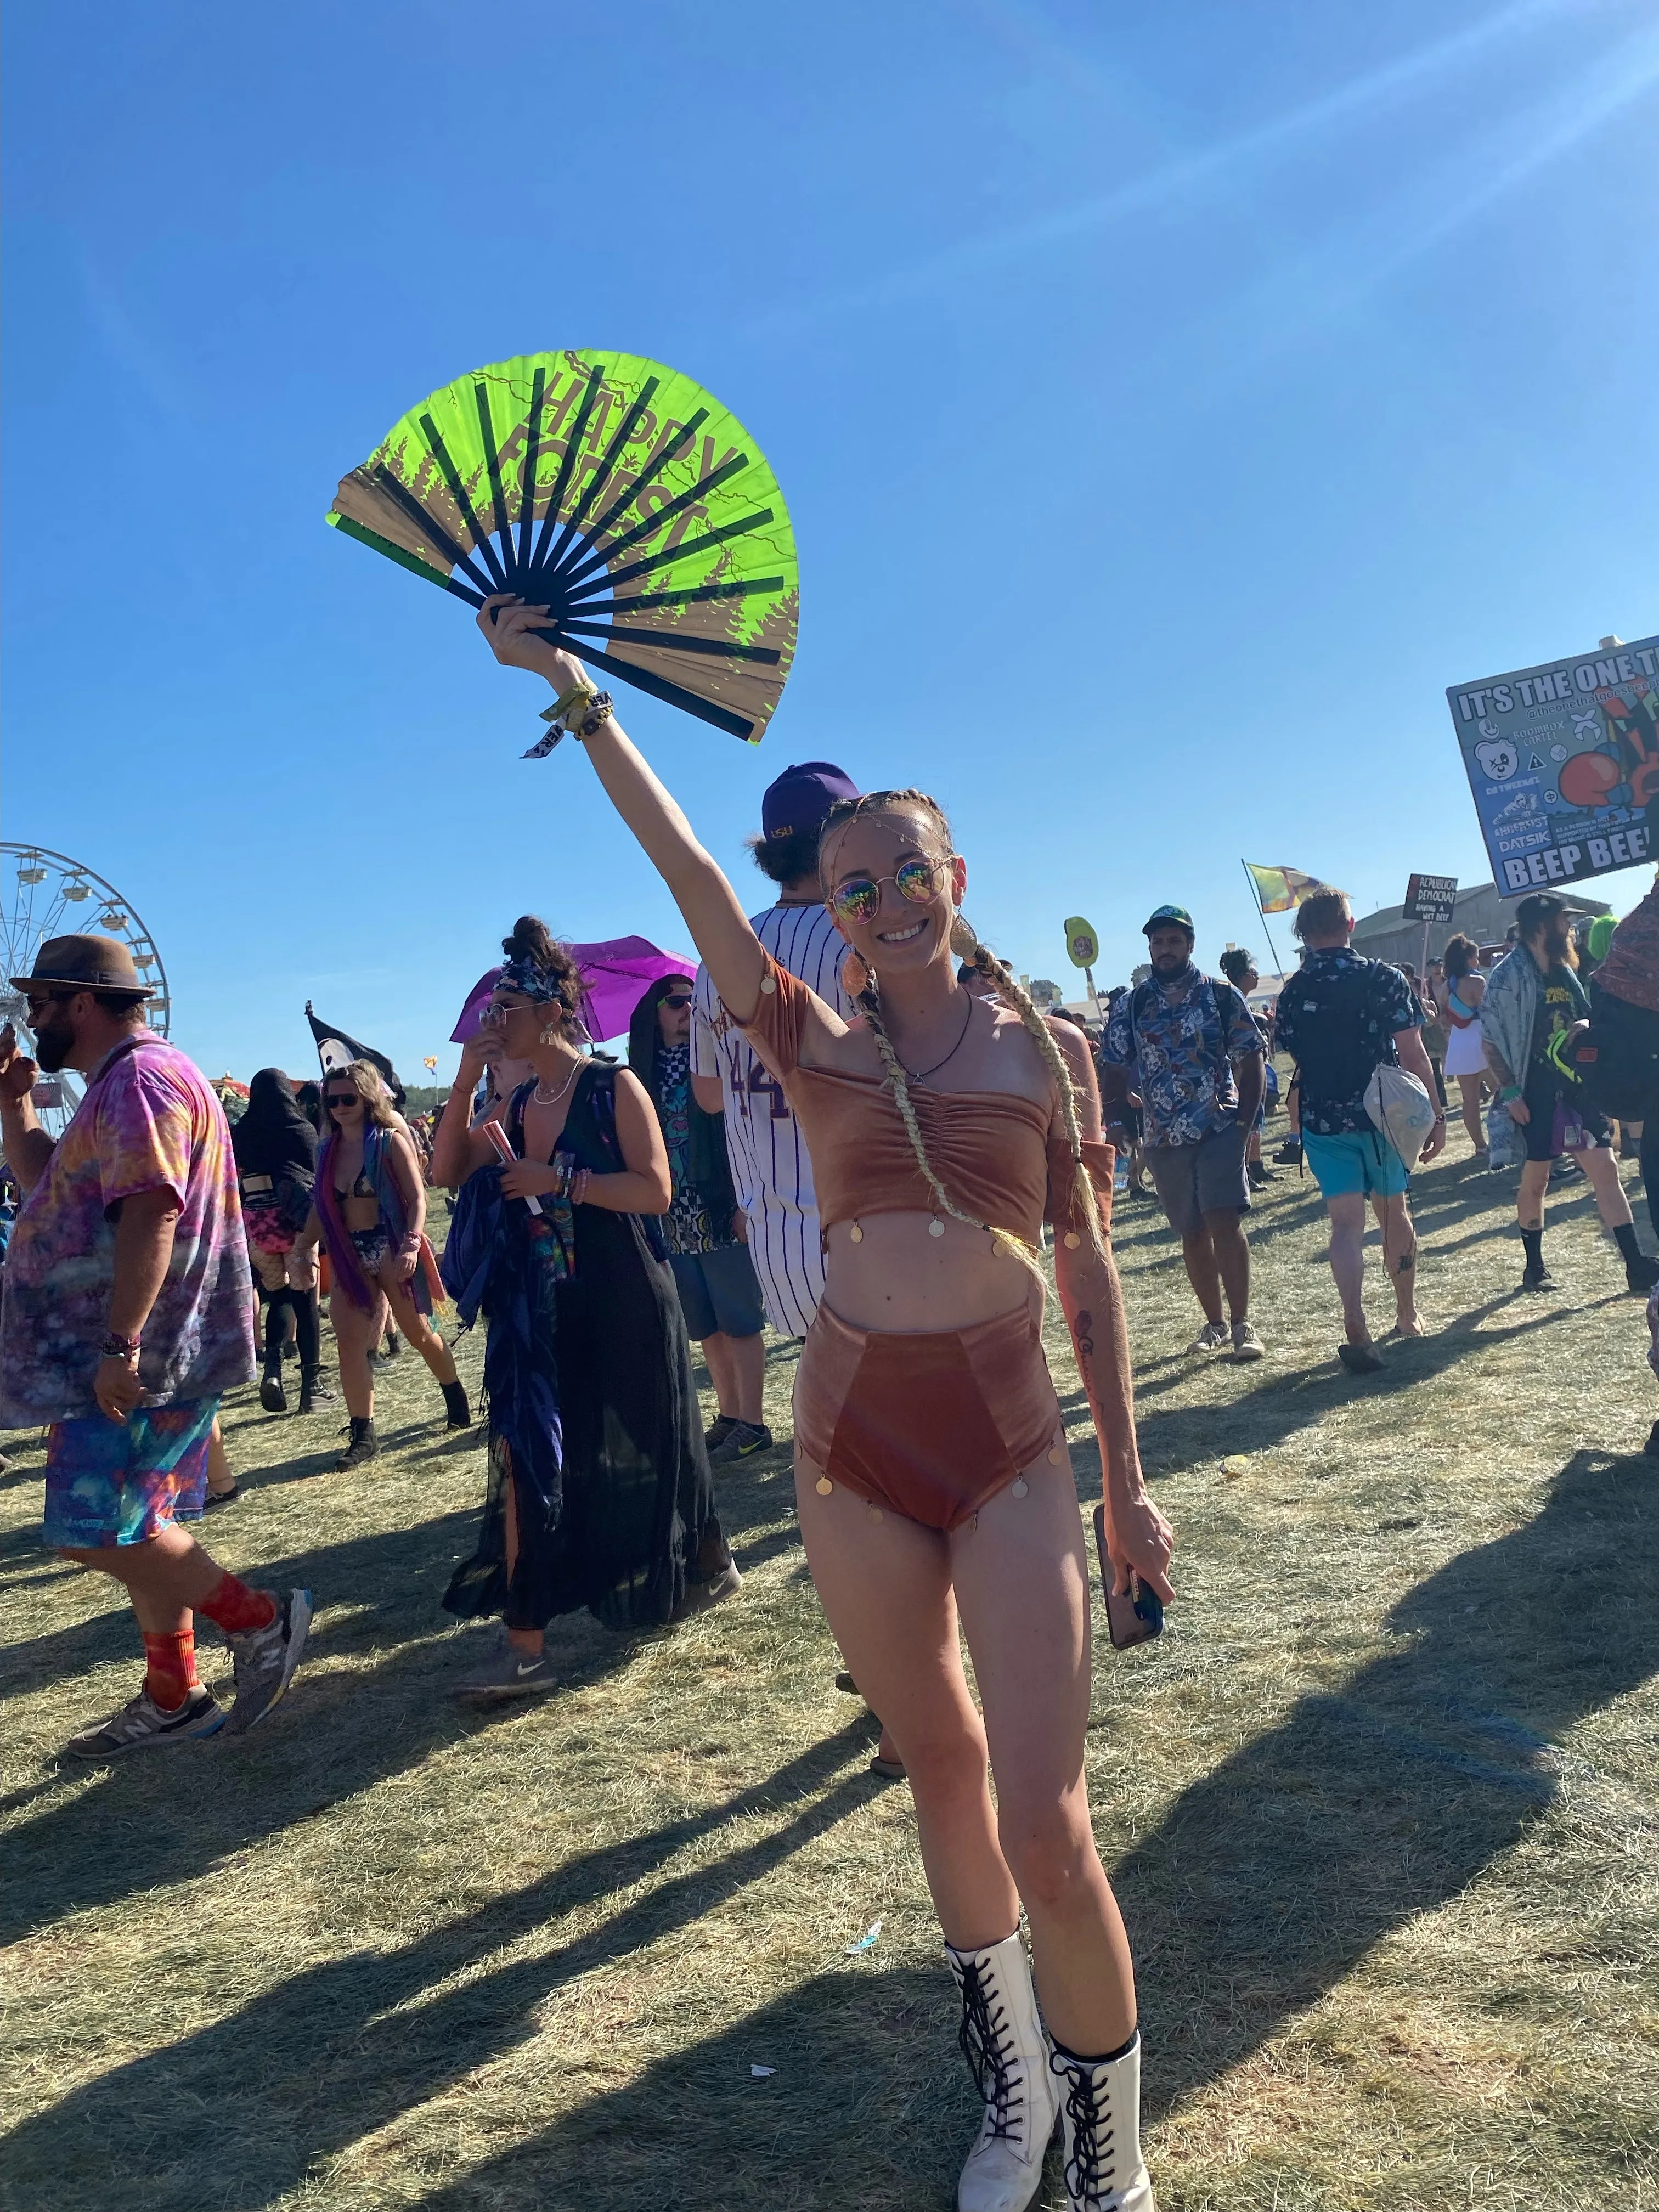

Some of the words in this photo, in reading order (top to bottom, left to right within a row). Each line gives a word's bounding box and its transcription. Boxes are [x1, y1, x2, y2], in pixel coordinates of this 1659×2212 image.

[523, 371, 739, 503] HAPPY
[488, 422, 709, 558] FOREST
[1458, 686, 1514, 720] IT'S
[1516, 671, 1572, 706] THE
[1575, 655, 1635, 692] ONE
[1635, 647, 1659, 675] T
[1513, 720, 1565, 740] BOOMBOX
[1523, 731, 1558, 746] CARTEL
[771, 825, 793, 838] LSU
[1499, 830, 1551, 853] DATSIK
[1504, 844, 1581, 889] BEEP
[1418, 890, 1455, 904] DEMOCRAT
[730, 1041, 791, 1120] 44
